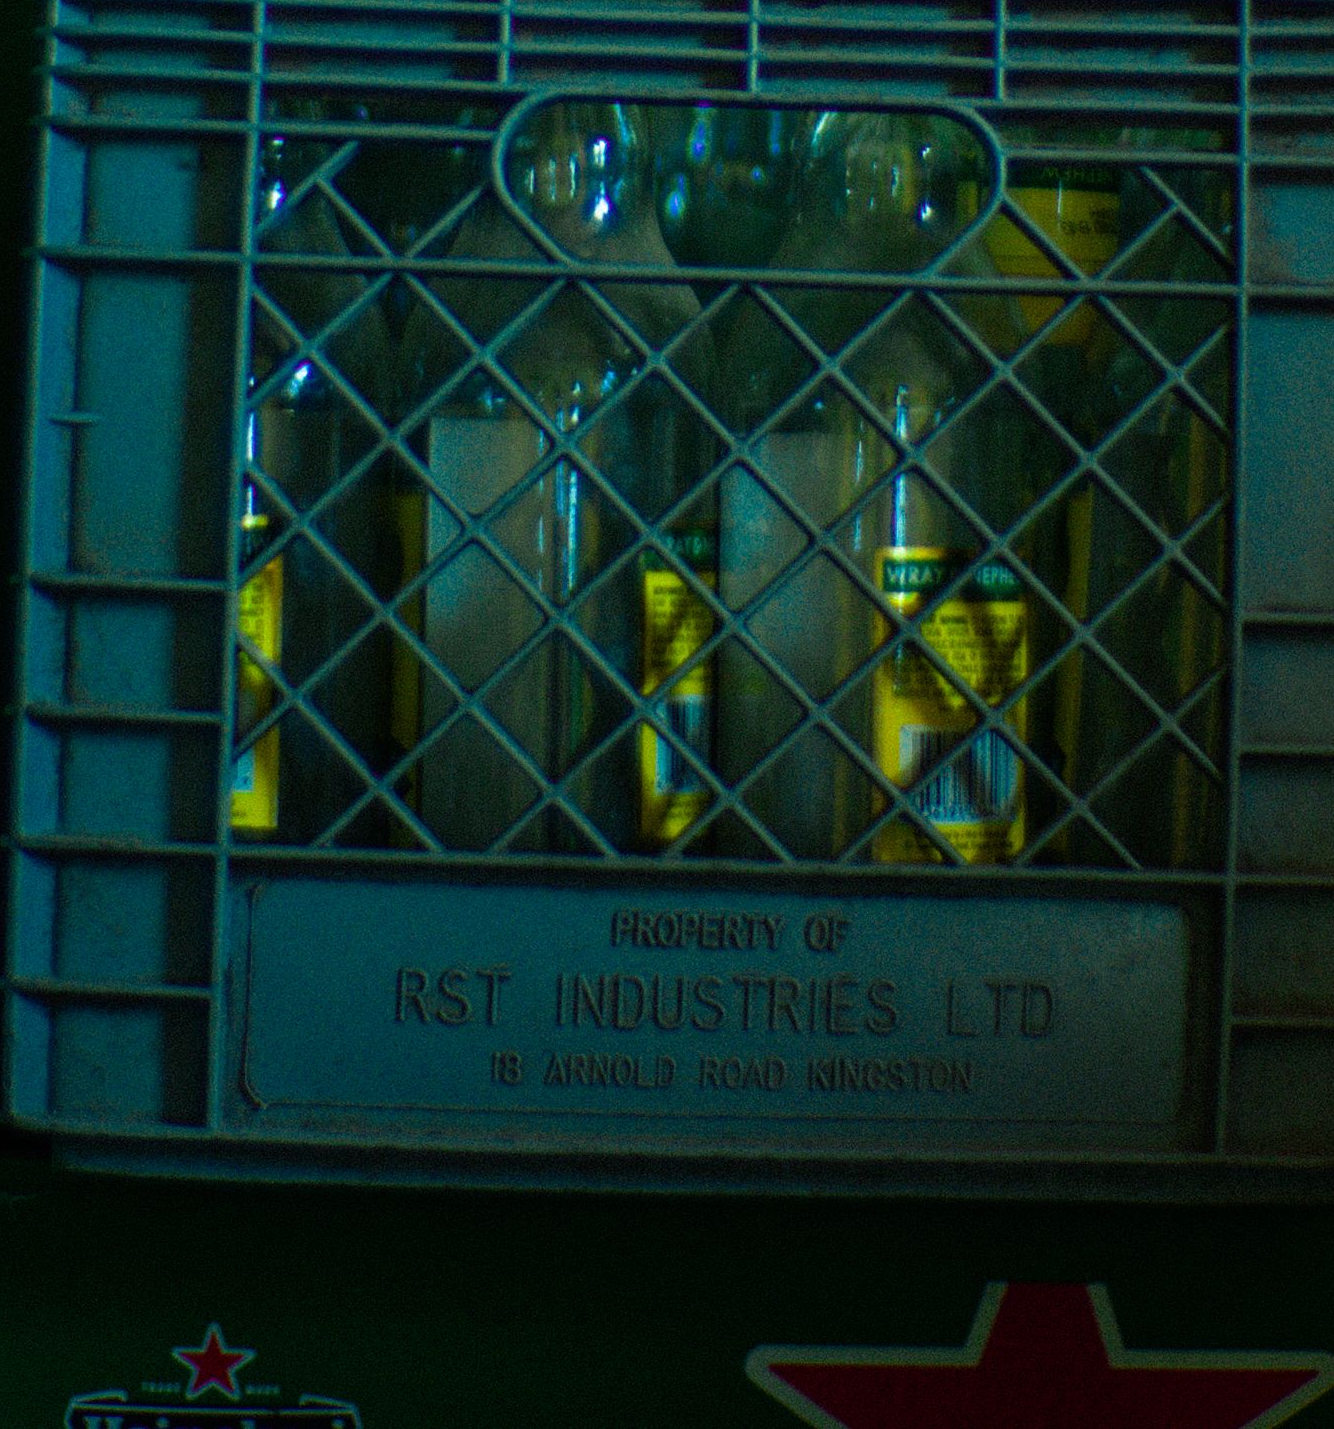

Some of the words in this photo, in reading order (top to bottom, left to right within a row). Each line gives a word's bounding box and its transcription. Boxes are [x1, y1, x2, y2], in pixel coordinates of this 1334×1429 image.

[610, 908, 784, 952] PROPERTY
[803, 912, 854, 953] OF
[393, 964, 513, 1027] RST
[555, 972, 899, 1038] INDUSTRIES
[947, 978, 1057, 1039] LTD
[543, 1052, 677, 1088] ARNOLD
[697, 1054, 787, 1090] ROAD
[808, 1058, 974, 1094] KINGSTON
